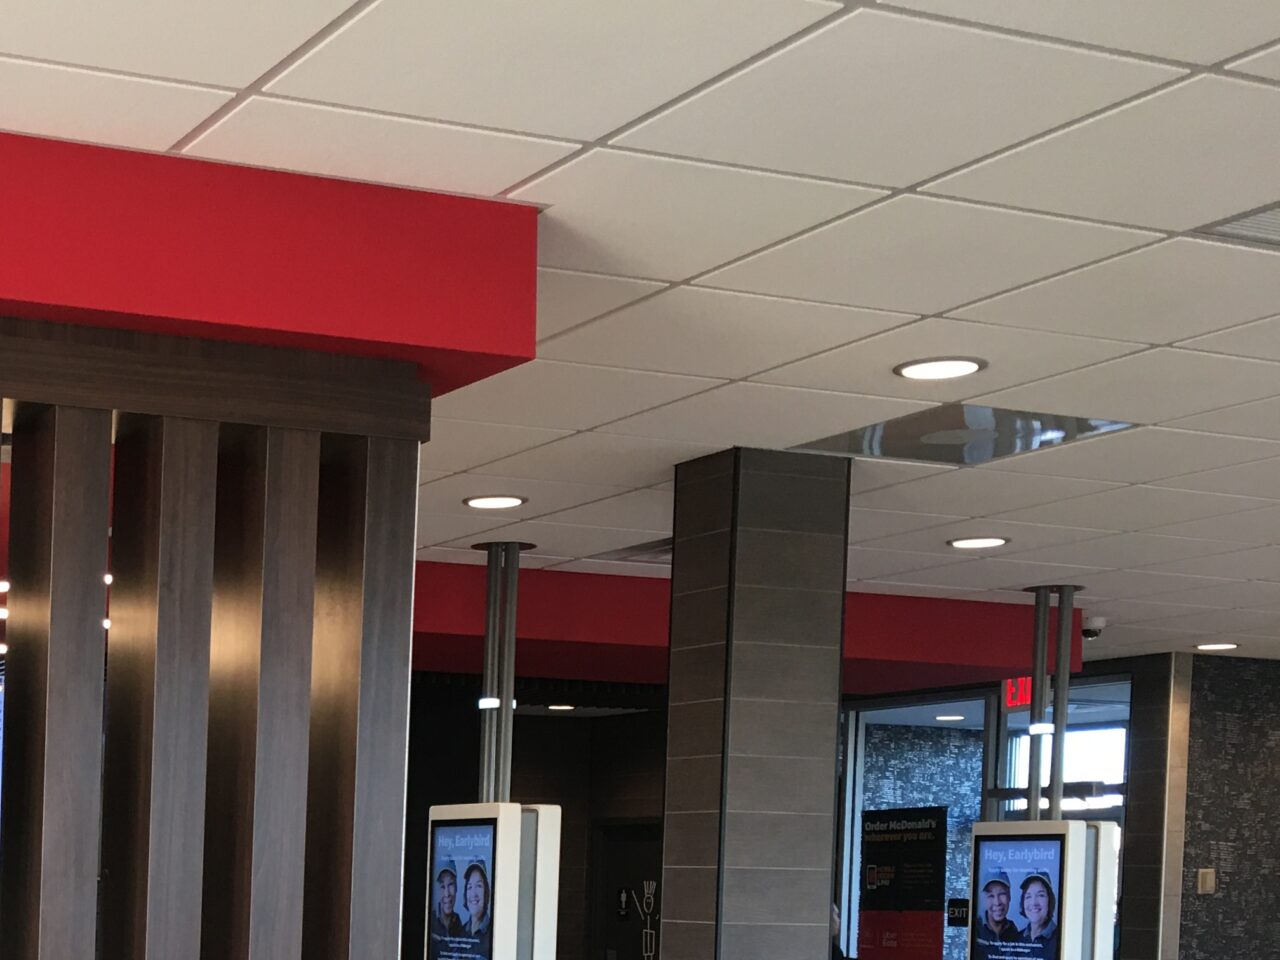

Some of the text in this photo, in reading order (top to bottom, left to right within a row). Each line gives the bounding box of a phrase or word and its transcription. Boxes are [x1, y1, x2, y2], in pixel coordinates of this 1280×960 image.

[1007, 677, 1032, 707] EXI
[865, 819, 936, 831] Order McDonald's
[438, 834, 490, 849] Hey, Earlybird
[985, 848, 1055, 863] Hey, Earlybird
[949, 907, 968, 918] EXIT
